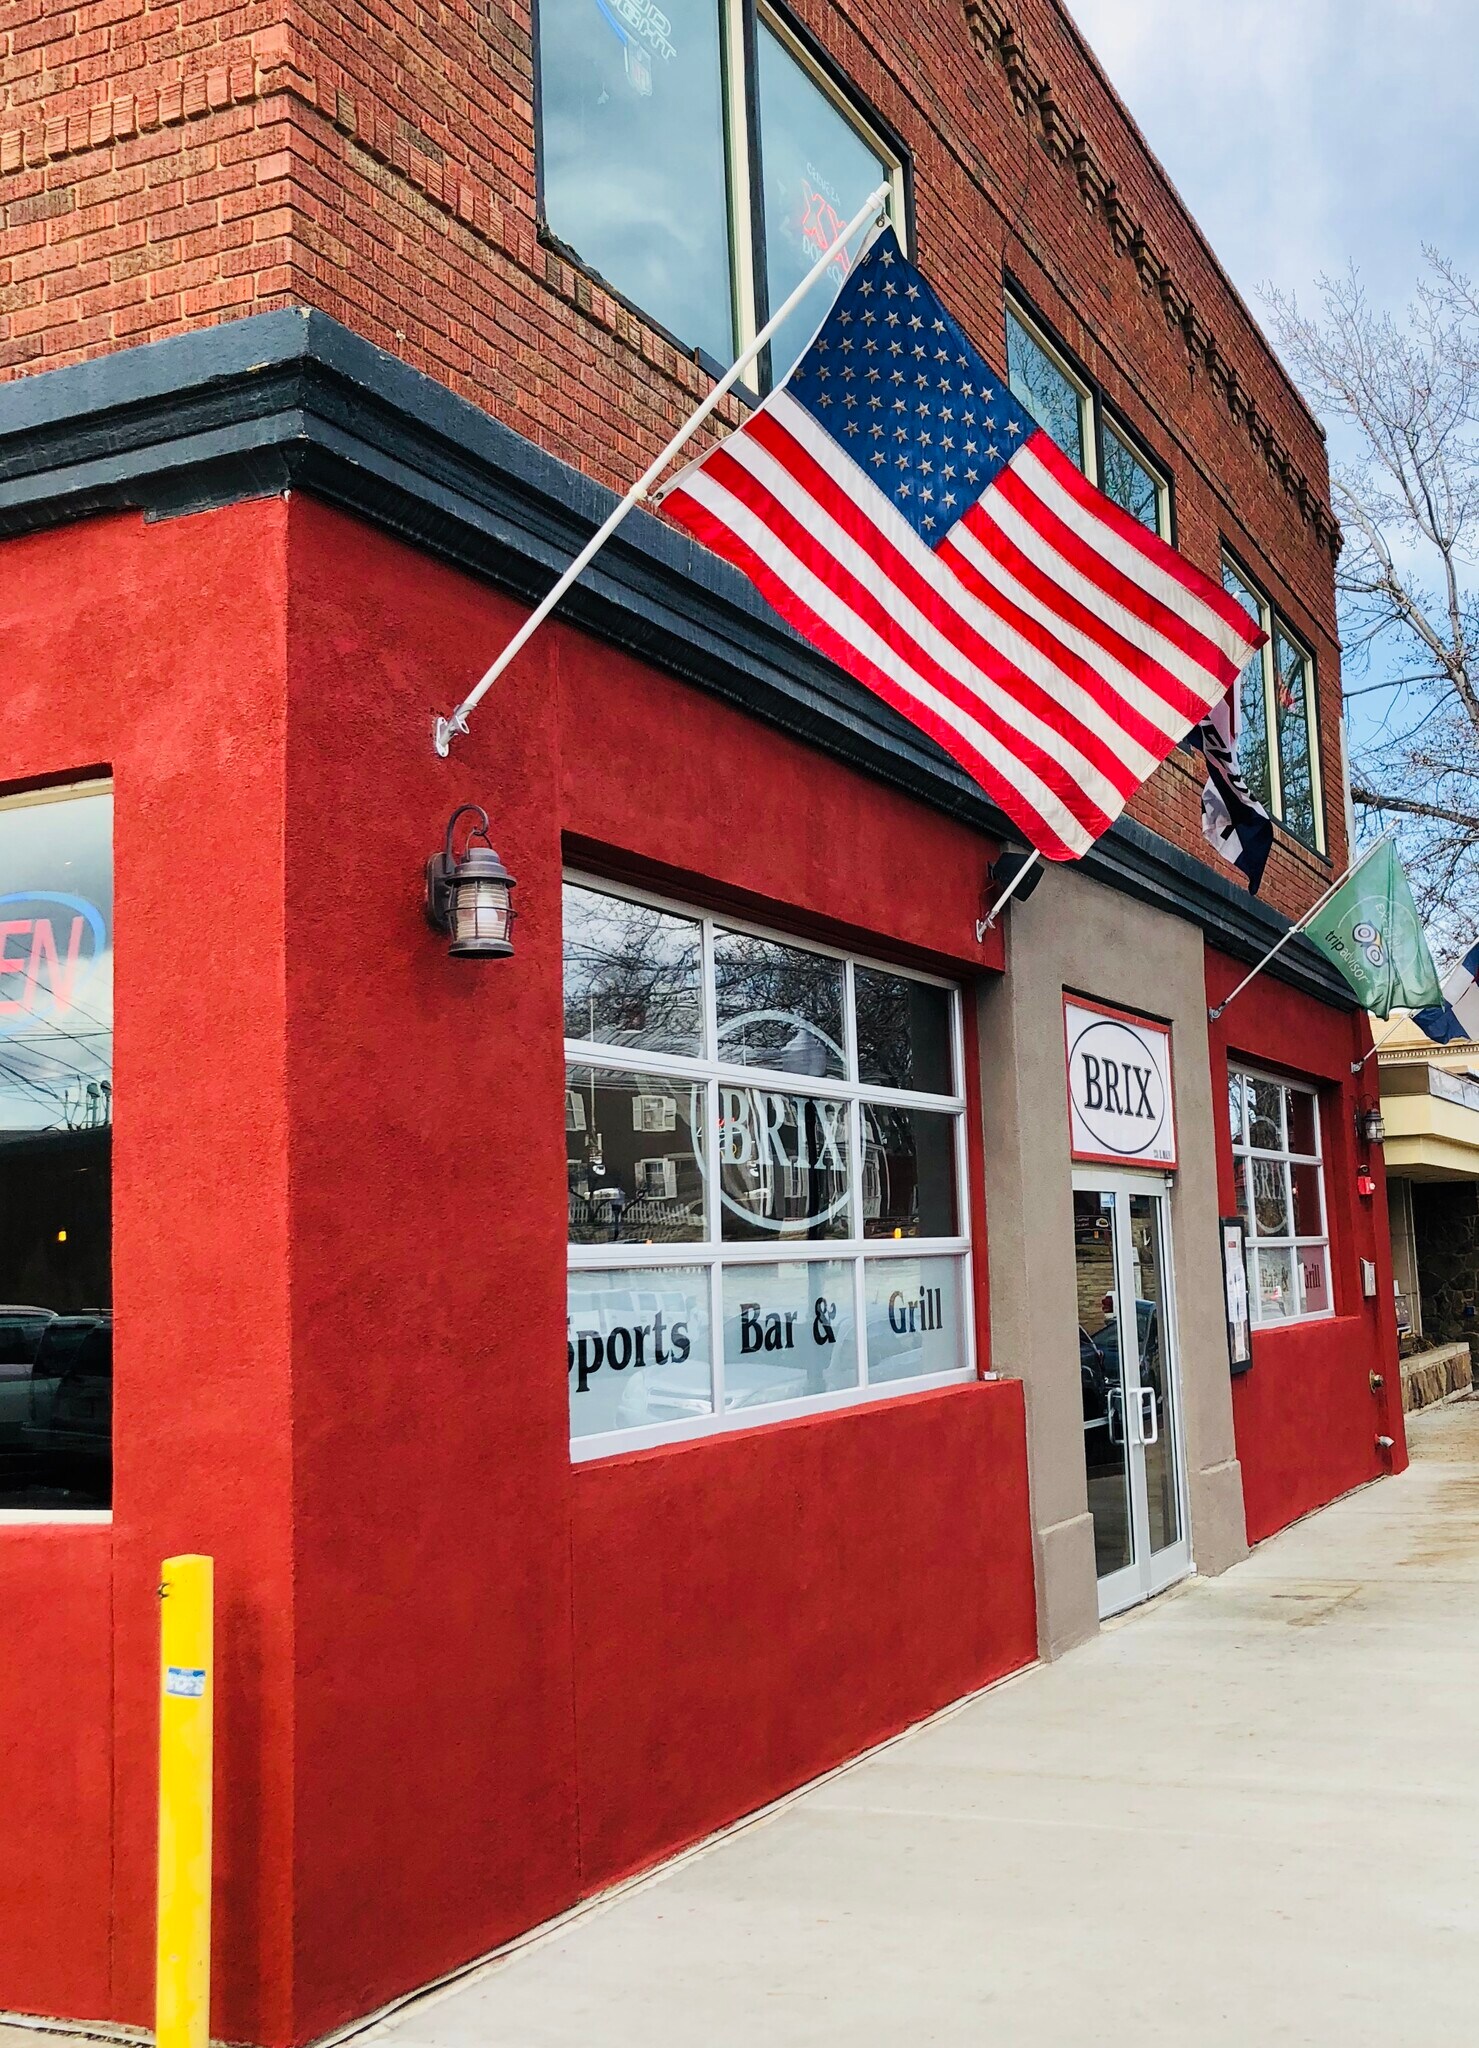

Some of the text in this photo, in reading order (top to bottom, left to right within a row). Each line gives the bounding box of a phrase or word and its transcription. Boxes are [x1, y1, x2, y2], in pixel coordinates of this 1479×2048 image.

[1325, 930, 1369, 983] tripadvisor
[1081, 1052, 1156, 1120] BRIX
[719, 1088, 847, 1172] BRIX
[739, 1302, 798, 1354] Bar
[812, 1296, 837, 1346] &
[888, 1285, 943, 1334] Grill
